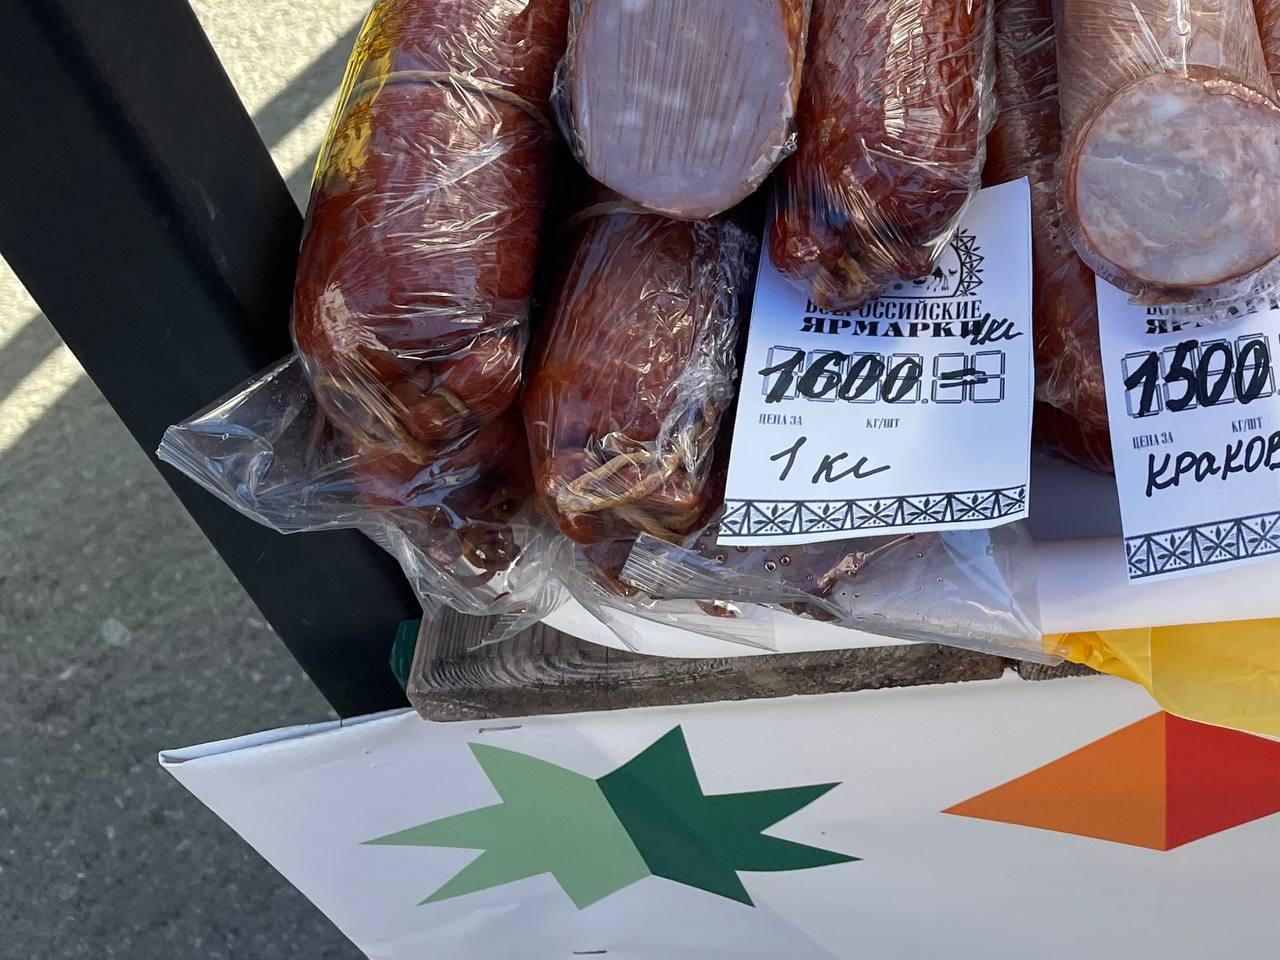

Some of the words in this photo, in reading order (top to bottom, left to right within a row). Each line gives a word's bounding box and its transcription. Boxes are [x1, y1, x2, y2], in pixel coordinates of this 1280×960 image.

[805, 298, 982, 320] ВОССИЙСКИЕ
[758, 413, 787, 426] ЦЕНА
[866, 418, 900, 429] КГ/ШТ
[1231, 416, 1263, 433] КГ/ШТ
[1132, 433, 1160, 450] ЦЕНА
